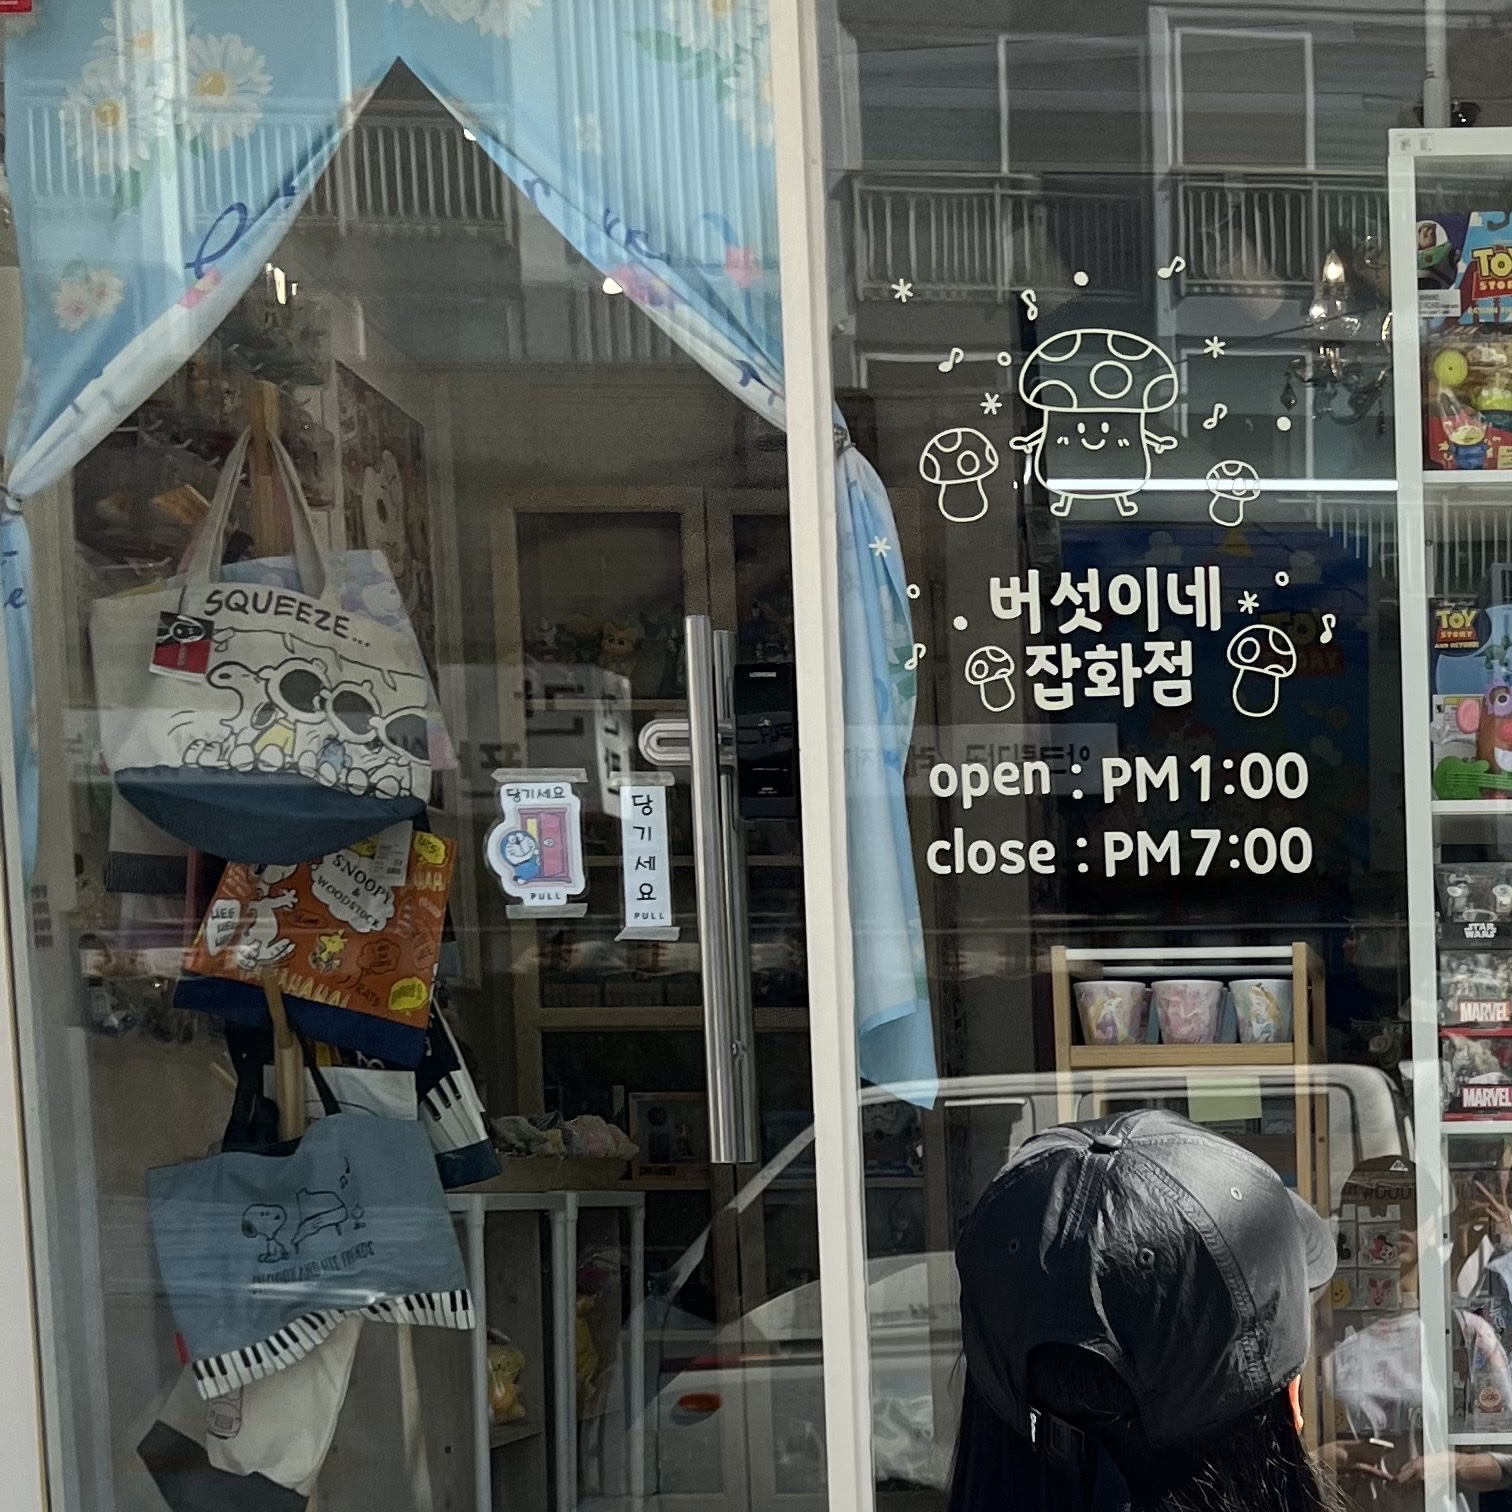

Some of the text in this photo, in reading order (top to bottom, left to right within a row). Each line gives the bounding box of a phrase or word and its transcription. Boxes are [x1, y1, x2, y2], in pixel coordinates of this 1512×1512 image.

[989, 565, 1223, 635] 버섯이네
[1435, 607, 1479, 630] TOY
[1025, 640, 1194, 712] 잡화점
[928, 758, 1052, 810] open
[1101, 754, 1181, 804] PM
[1190, 752, 1311, 803] 1:00
[506, 785, 567, 803] 당기세요
[926, 827, 1056, 875] close
[1104, 829, 1181, 878] PM
[1190, 826, 1314, 878] 7:00
[331, 853, 396, 906] SNOOPY
[316, 875, 381, 929] WOODSTOCK
[530, 891, 562, 901] PULL
[633, 911, 665, 920] PULL
[1464, 922, 1496, 931] STAR
[1463, 929, 1497, 939] WARS
[1459, 1001, 1511, 1023] MARVEL
[1463, 1087, 1512, 1108] MARVEL
